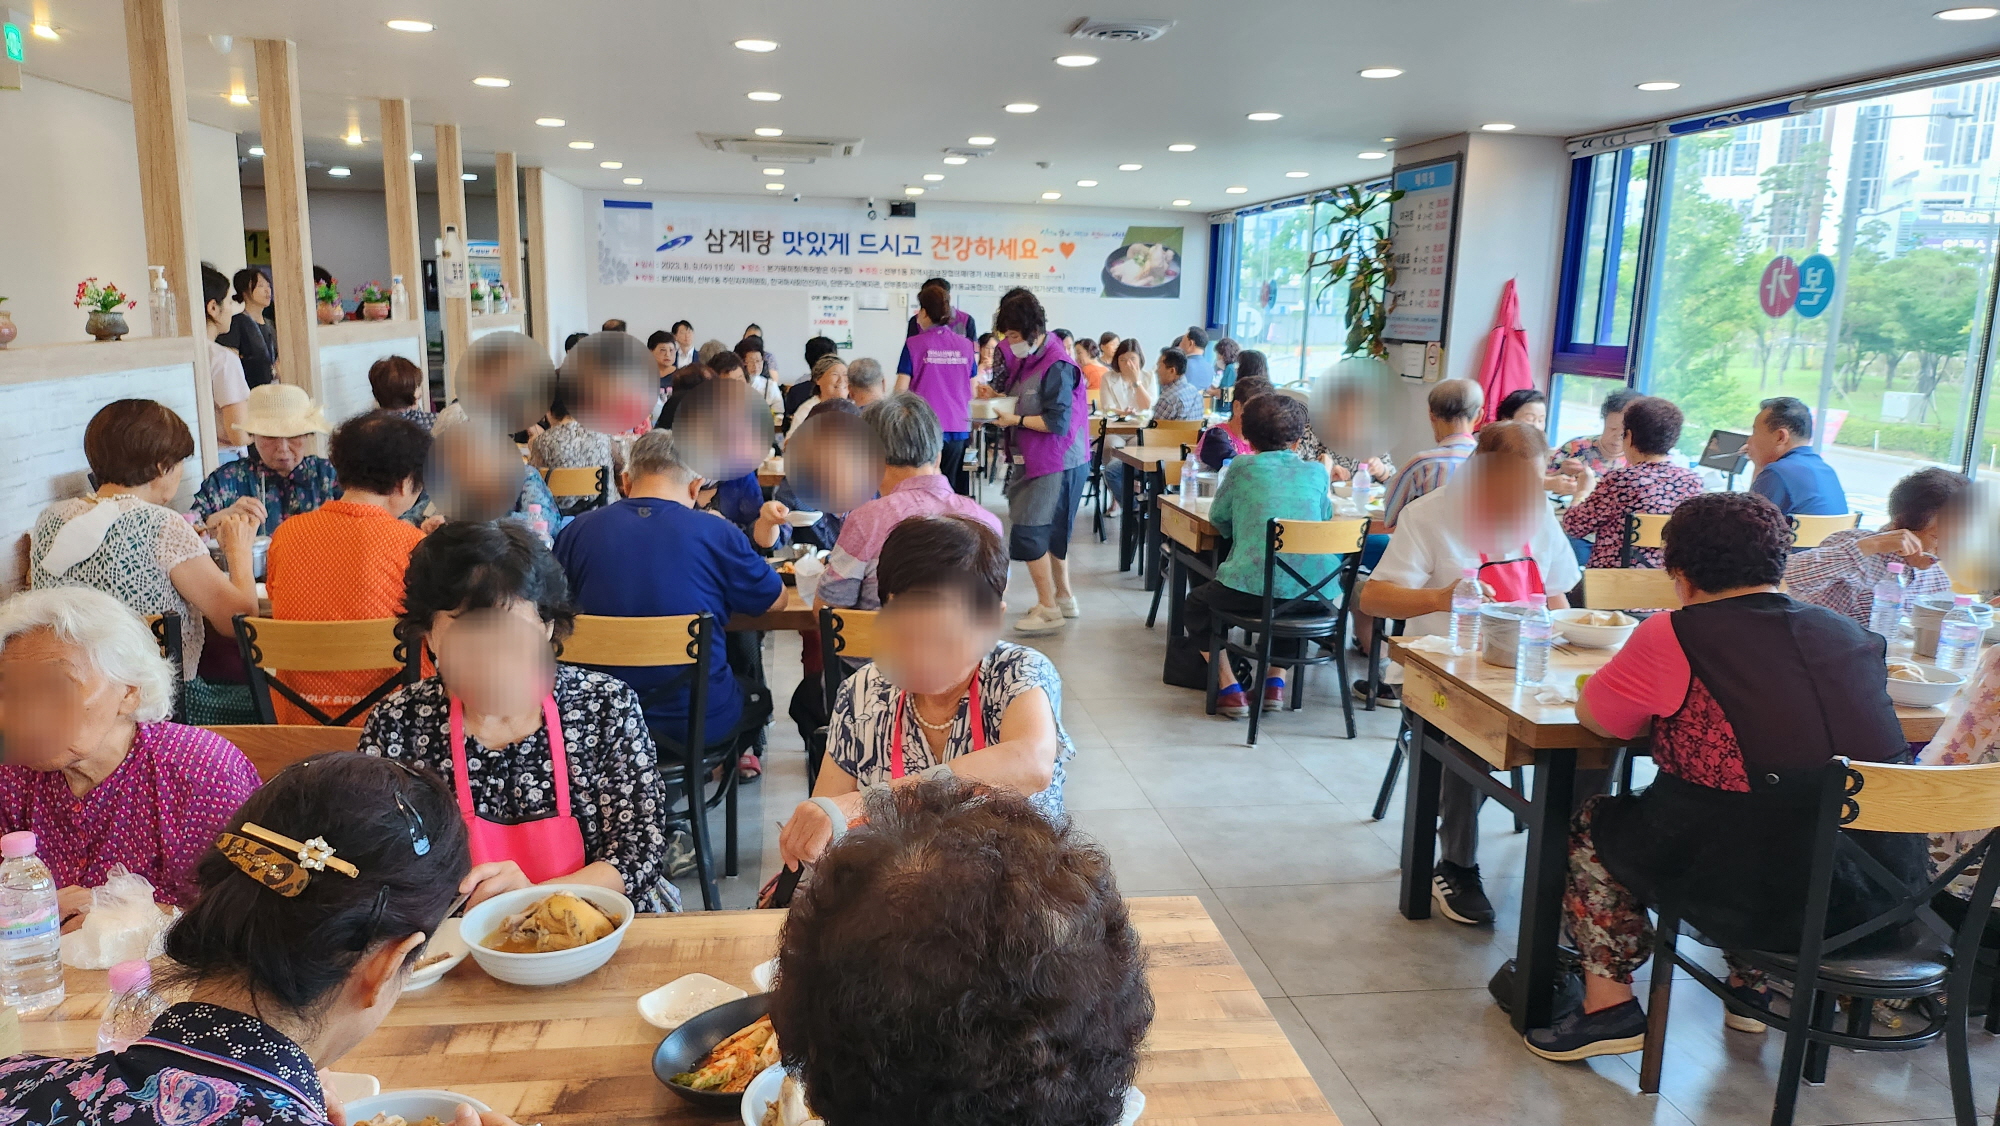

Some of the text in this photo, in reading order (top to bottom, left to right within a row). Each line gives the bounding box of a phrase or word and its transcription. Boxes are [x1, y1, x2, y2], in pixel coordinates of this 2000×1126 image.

[704, 228, 1055, 262] 삼계탕 맛있게 드시고 건강하세요~
[333, 694, 368, 705] SPO
